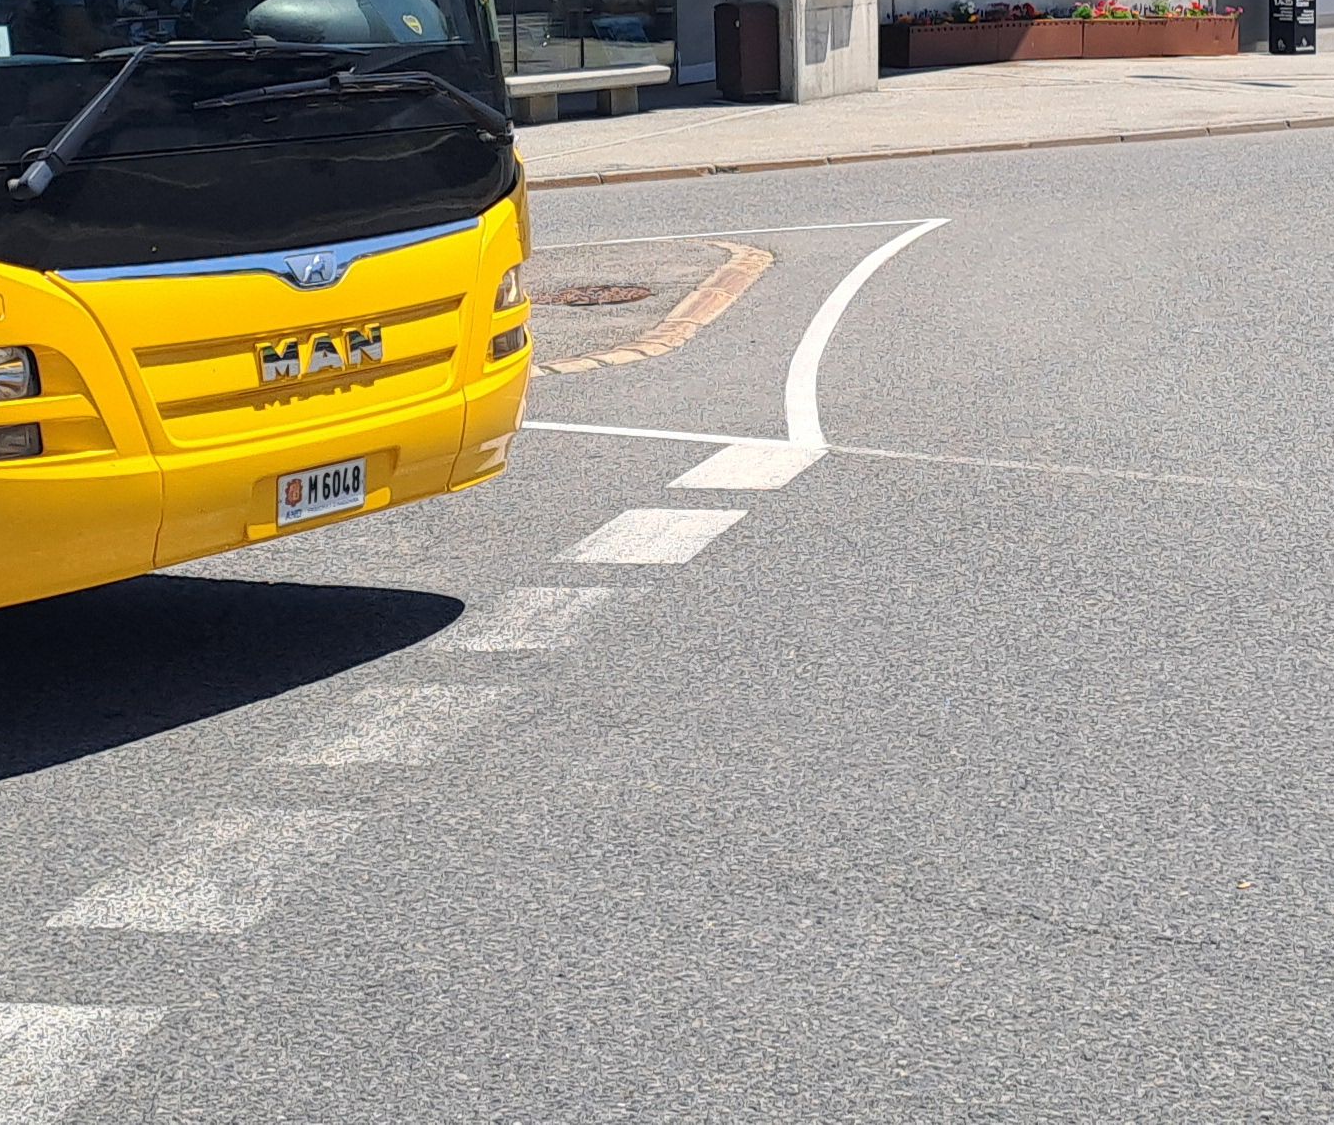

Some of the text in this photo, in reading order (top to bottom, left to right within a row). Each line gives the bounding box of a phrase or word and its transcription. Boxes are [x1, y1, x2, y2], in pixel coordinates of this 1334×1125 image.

[255, 322, 383, 383] MAN
[307, 465, 361, 505] M 6048
